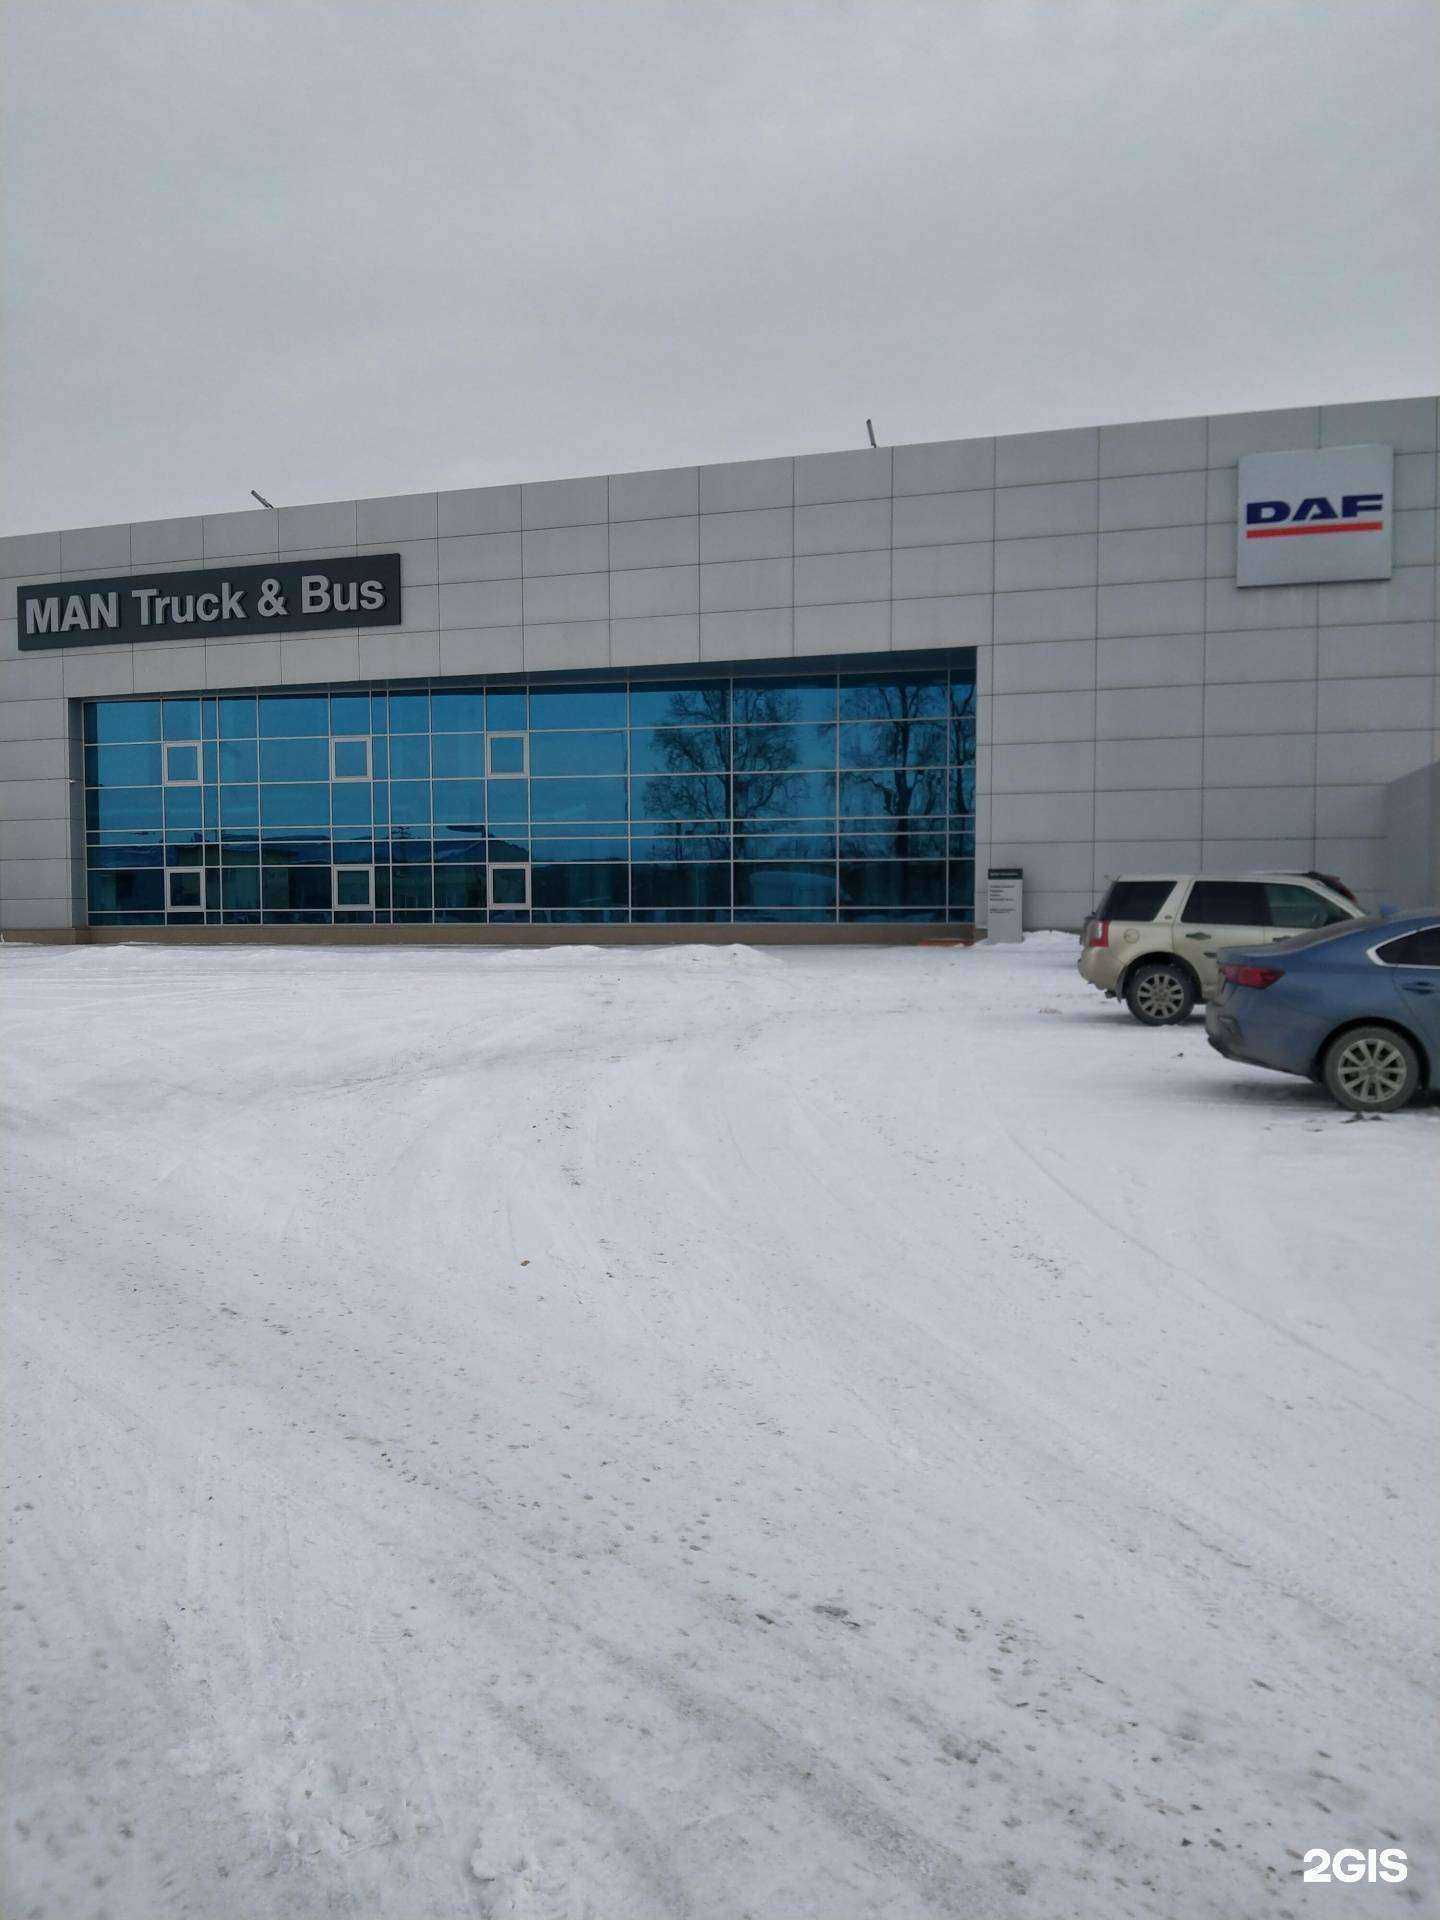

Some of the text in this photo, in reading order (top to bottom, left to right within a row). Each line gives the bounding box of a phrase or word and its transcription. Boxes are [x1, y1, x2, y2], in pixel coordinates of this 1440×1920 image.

[1246, 493, 1384, 525] DAF
[25, 575, 385, 634] MAN Truck & Bus
